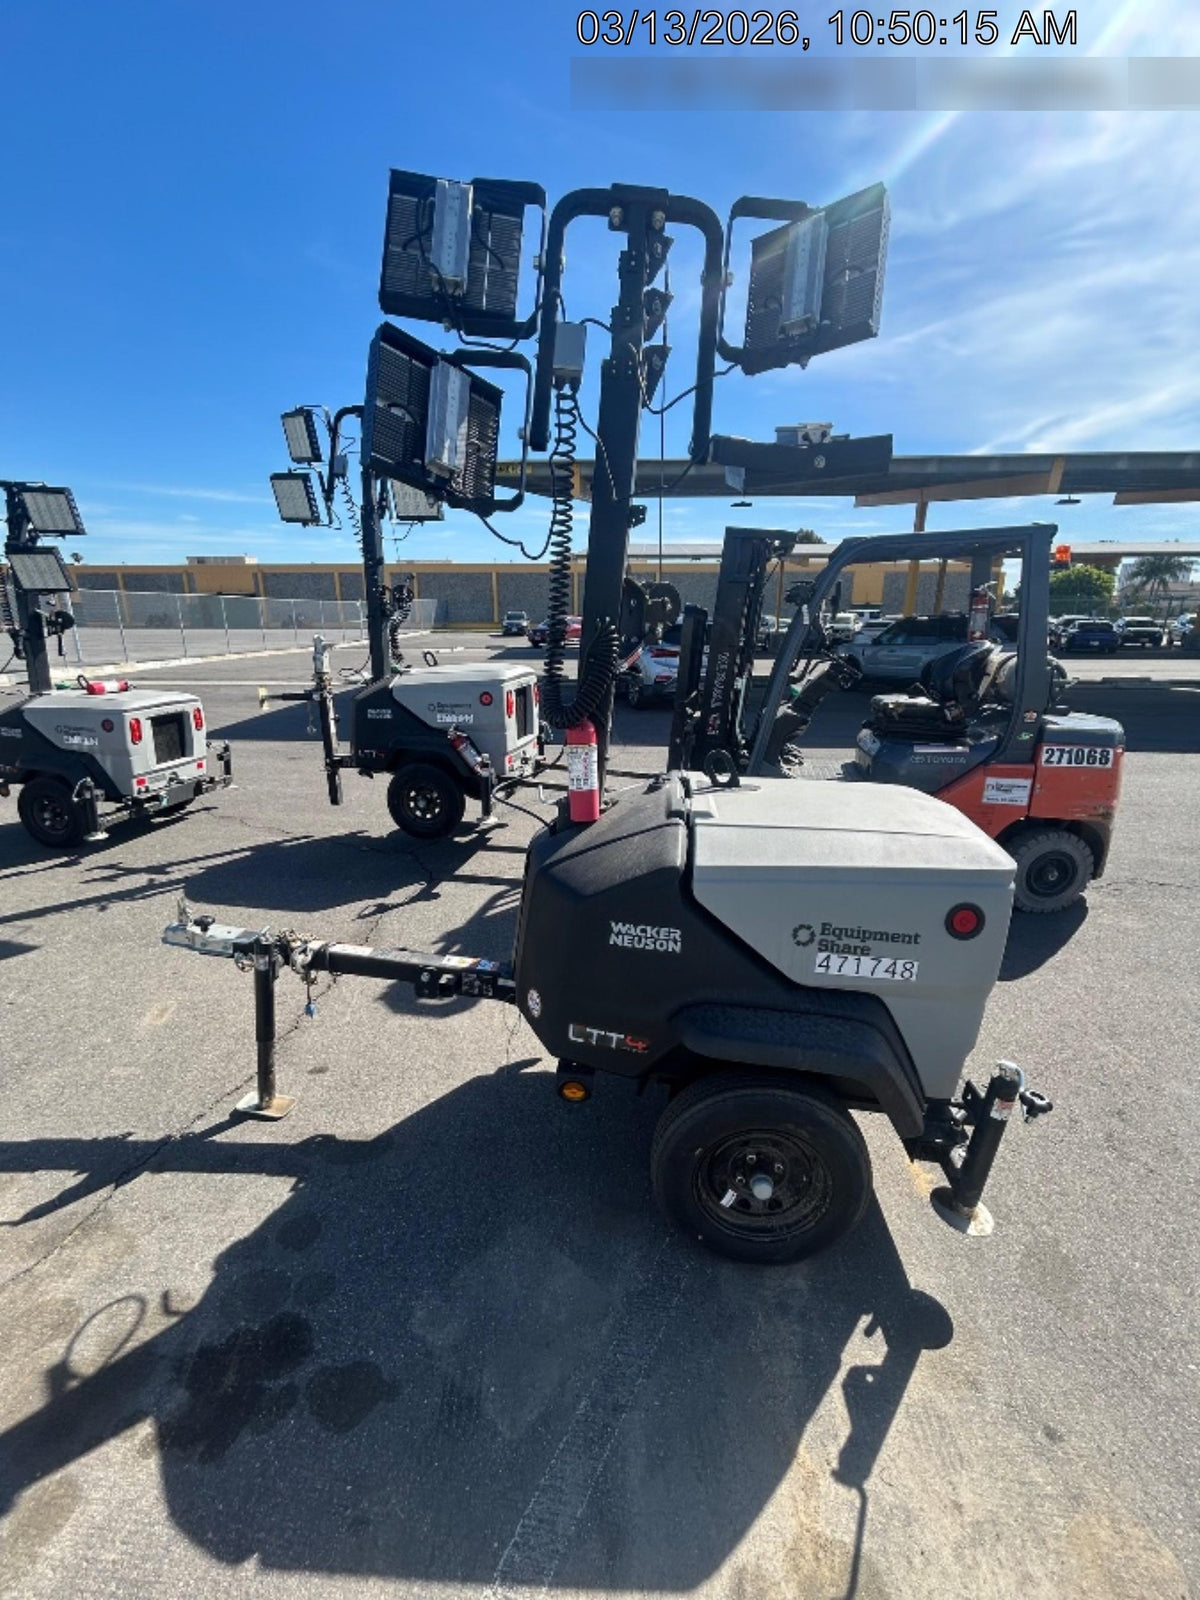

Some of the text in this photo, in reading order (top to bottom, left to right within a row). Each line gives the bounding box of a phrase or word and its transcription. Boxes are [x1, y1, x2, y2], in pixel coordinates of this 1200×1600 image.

[1044, 748, 1111, 766] 271068
[609, 920, 682, 941] WACKER
[820, 922, 921, 945] Equipment
[609, 932, 682, 954] NEUSON
[817, 938, 872, 956] Share
[817, 954, 915, 979] 471748
